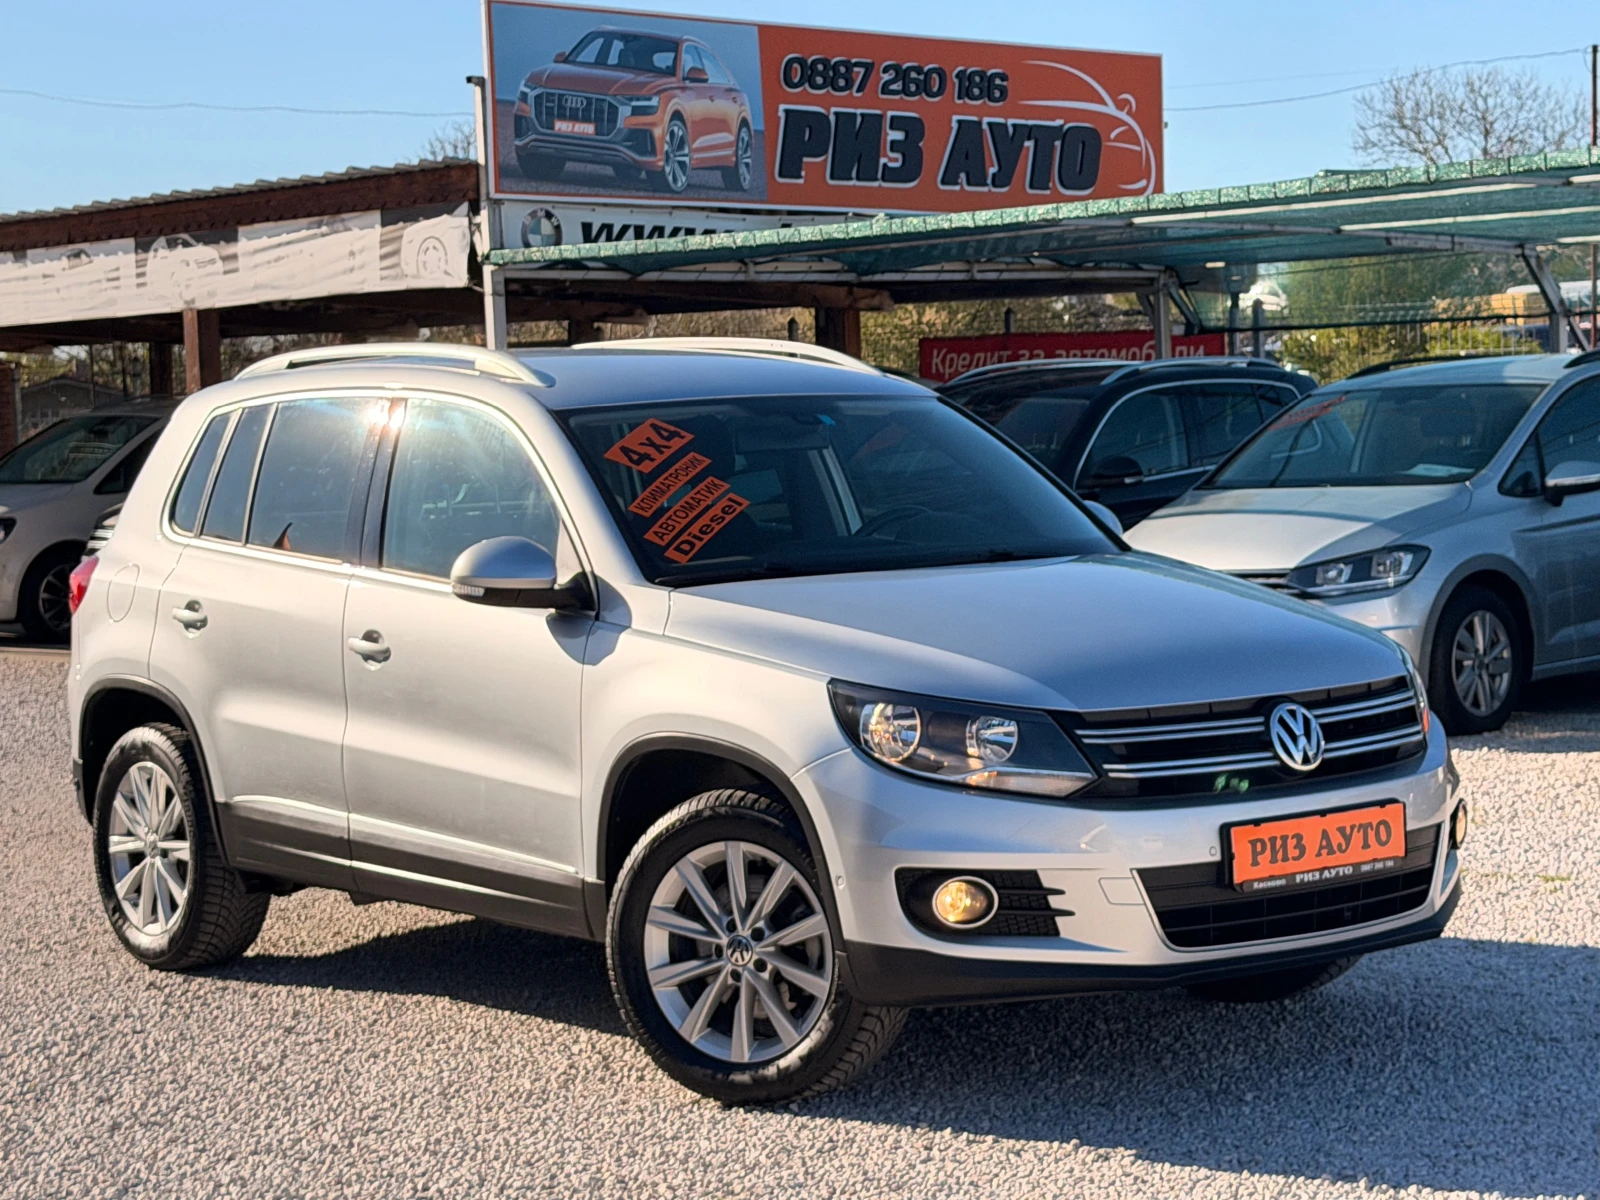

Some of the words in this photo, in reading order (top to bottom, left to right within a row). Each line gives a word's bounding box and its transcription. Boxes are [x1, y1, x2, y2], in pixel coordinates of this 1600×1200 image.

[782, 54, 875, 96] 0887
[879, 61, 947, 102] 260
[954, 67, 1009, 104] 186
[776, 104, 925, 187] РИЗ
[937, 115, 1103, 195] АУТО
[931, 348, 1013, 380] Кредит
[634, 454, 706, 513] КЛИМАТРОНИК
[653, 478, 724, 541] АВТОМАТИК
[673, 497, 744, 557] Diesel
[1248, 832, 1307, 867] РИЗ
[1315, 818, 1392, 858] АУТО
[1295, 871, 1320, 883] РИЗ
[1322, 865, 1353, 879] АУТО
